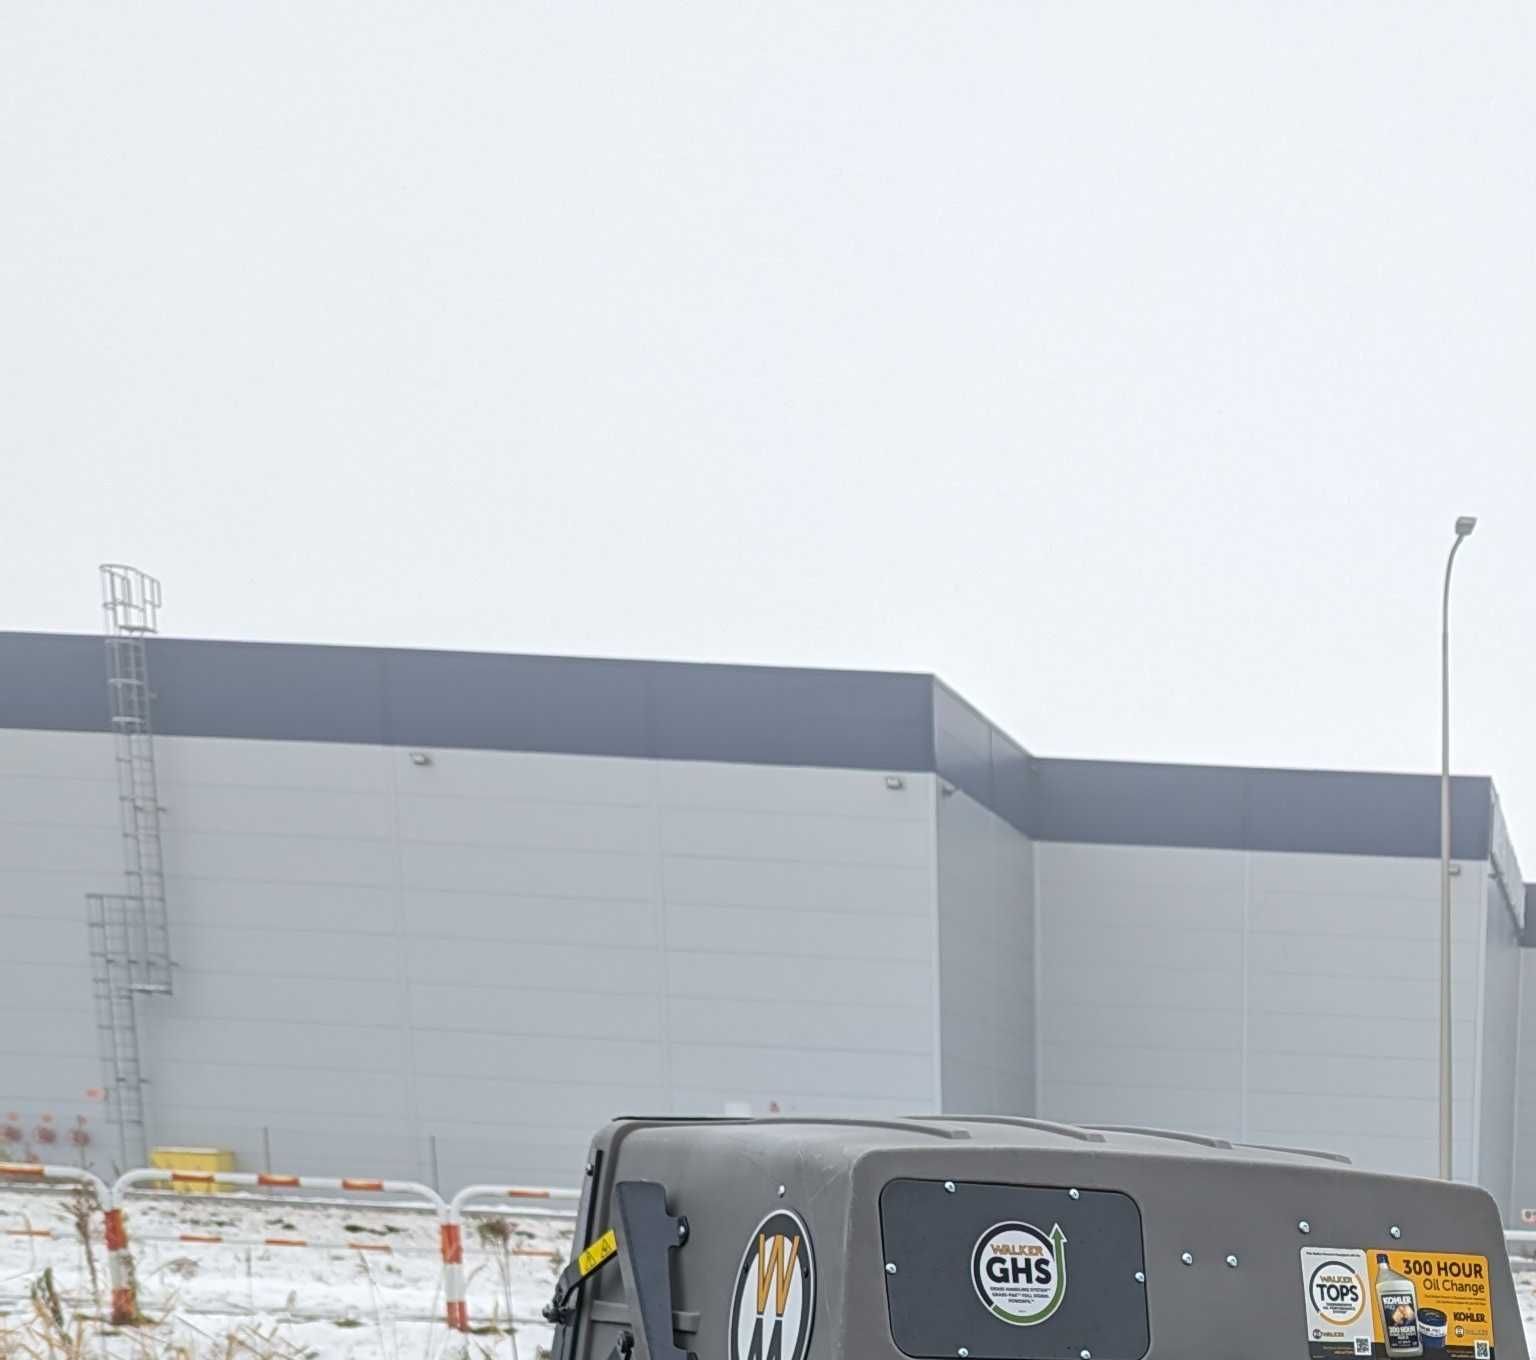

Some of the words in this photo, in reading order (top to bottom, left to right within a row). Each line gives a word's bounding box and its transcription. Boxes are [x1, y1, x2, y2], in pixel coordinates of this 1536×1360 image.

[991, 1244, 1043, 1256] WALKER
[986, 1256, 1052, 1285] GHS
[1402, 1260, 1433, 1276] 300
[1437, 1262, 1483, 1278] HOUR
[1320, 1276, 1353, 1284] WALKER
[1316, 1284, 1359, 1302] TOPS
[1423, 1279, 1440, 1291] Oil
[1442, 1280, 1485, 1296] Change
[1383, 1296, 1412, 1305] KOHLER
[1453, 1312, 1487, 1323] KOHLER
